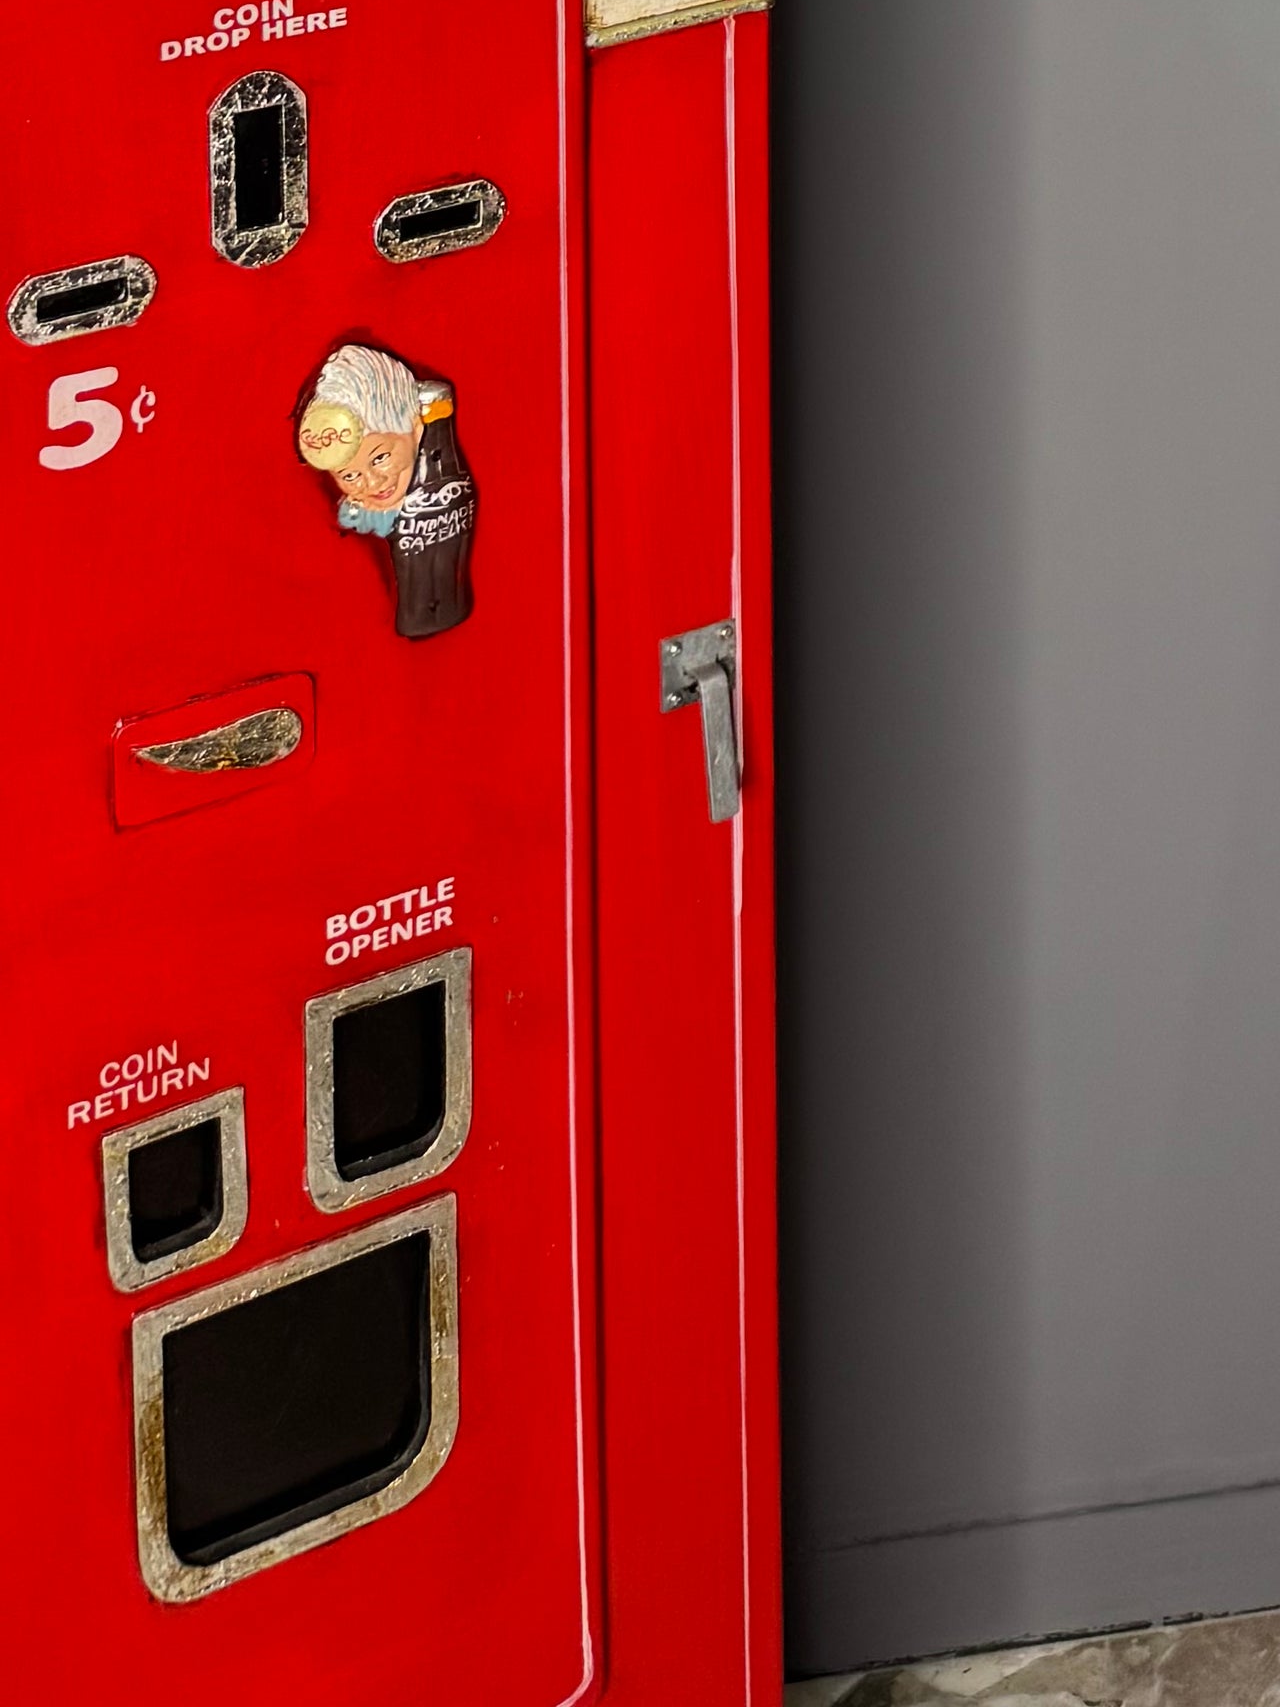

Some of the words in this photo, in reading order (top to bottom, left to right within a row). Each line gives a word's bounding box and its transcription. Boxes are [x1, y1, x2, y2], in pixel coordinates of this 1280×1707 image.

[160, 27, 251, 62] DROP
[261, 7, 348, 42] HERE
[325, 906, 454, 966] OPENER
[326, 876, 456, 940] BOTTLE
[67, 1057, 210, 1130] RETURN
[99, 1039, 178, 1088] COIN
